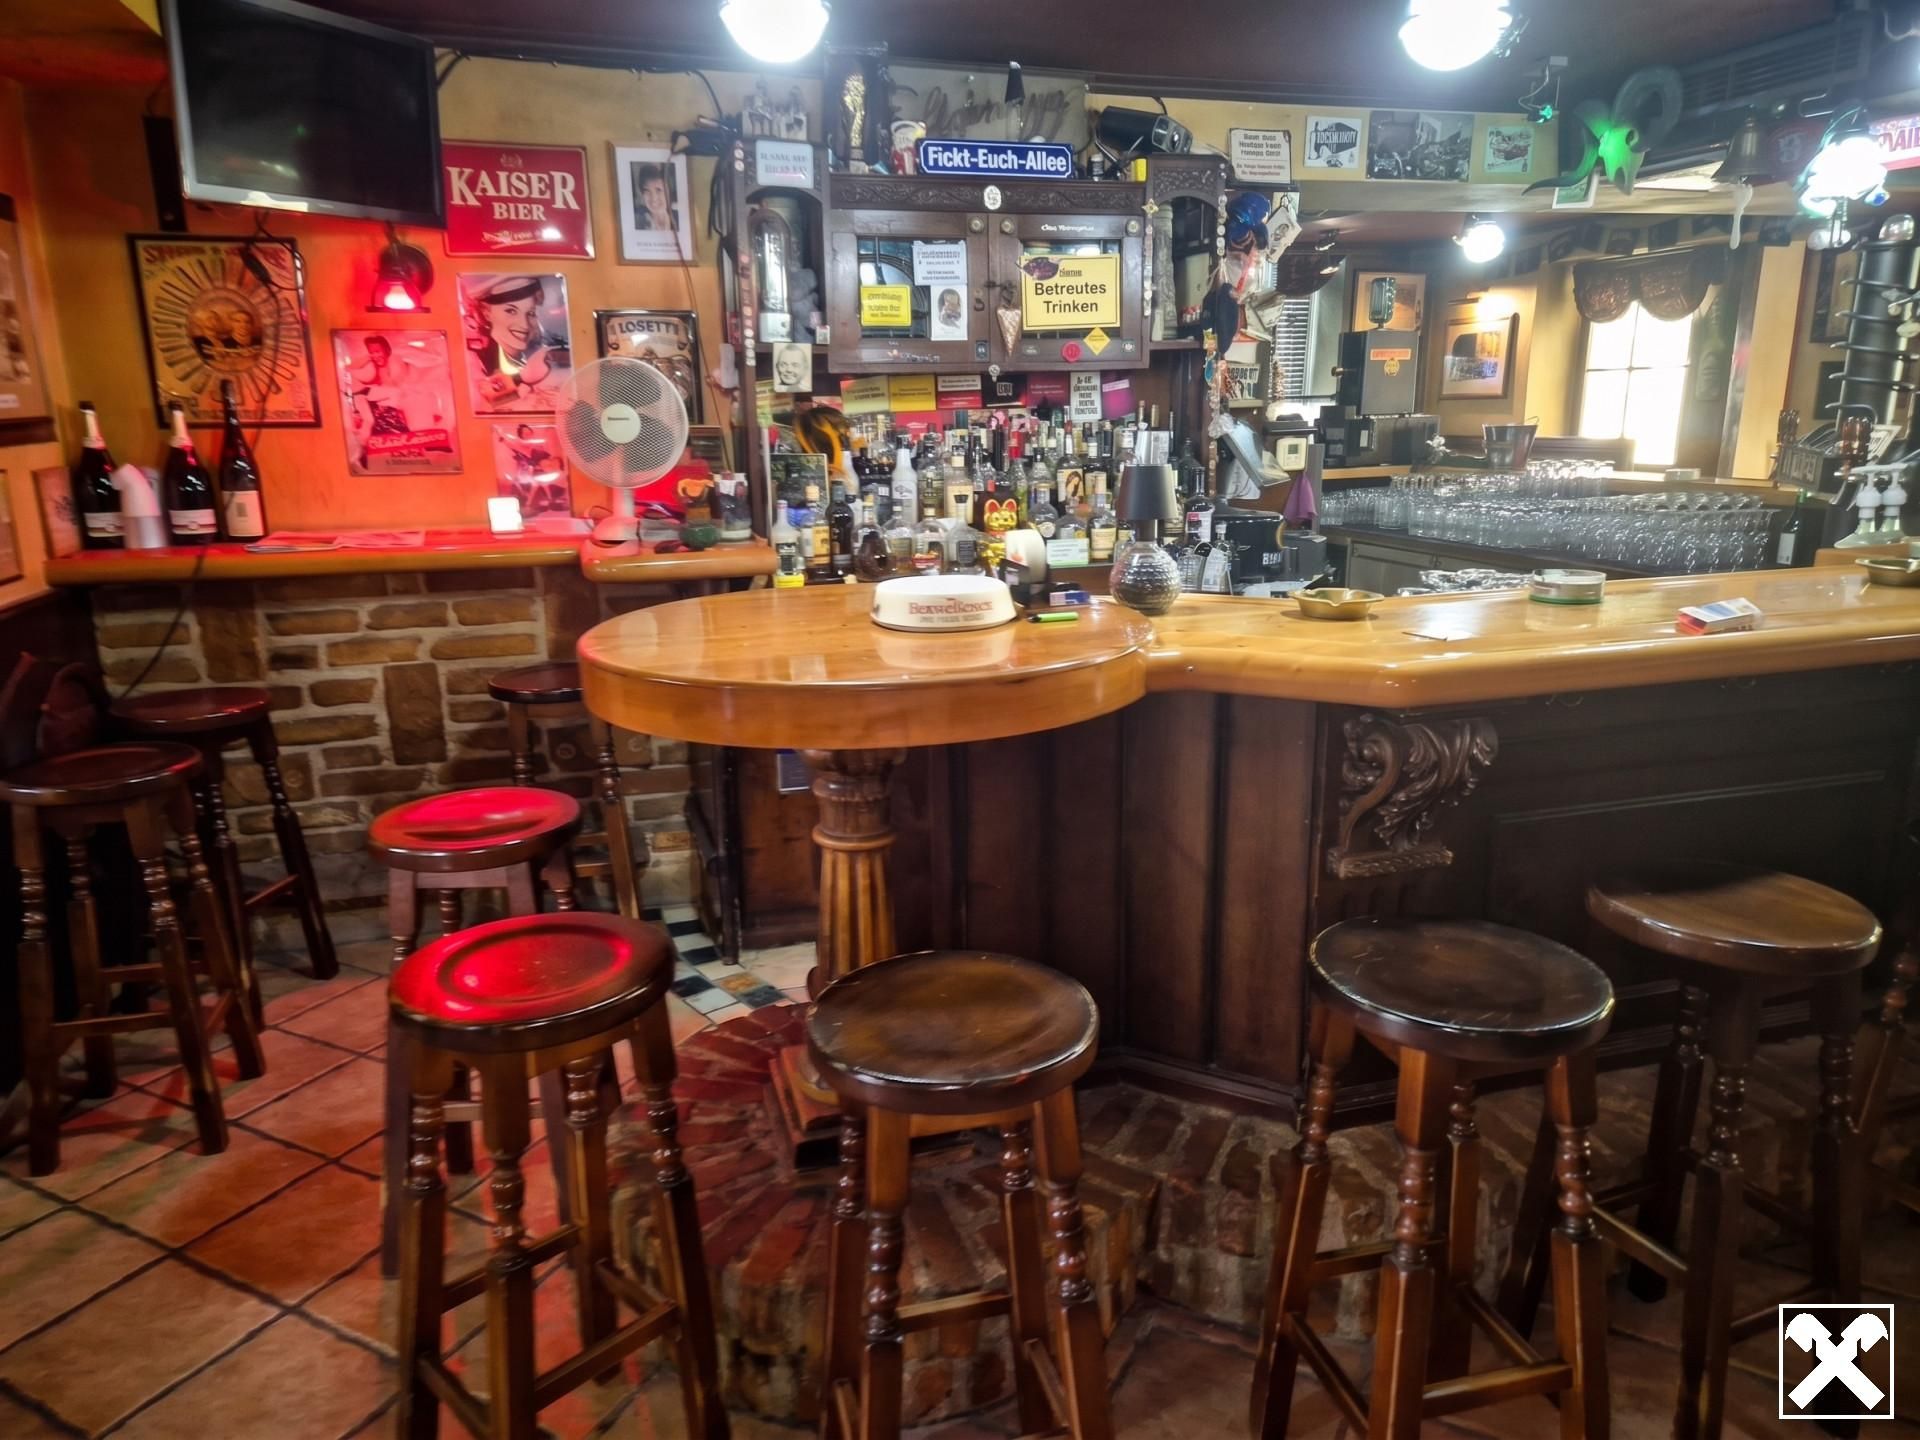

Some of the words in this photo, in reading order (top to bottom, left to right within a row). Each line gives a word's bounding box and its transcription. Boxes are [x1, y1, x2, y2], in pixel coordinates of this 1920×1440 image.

[927, 146, 1067, 172] Fickt-Euch-Allee
[446, 166, 580, 210] KAISER
[491, 201, 547, 221] BIER
[1034, 282, 1107, 296] Betreutes
[1043, 299, 1099, 314] Trinken
